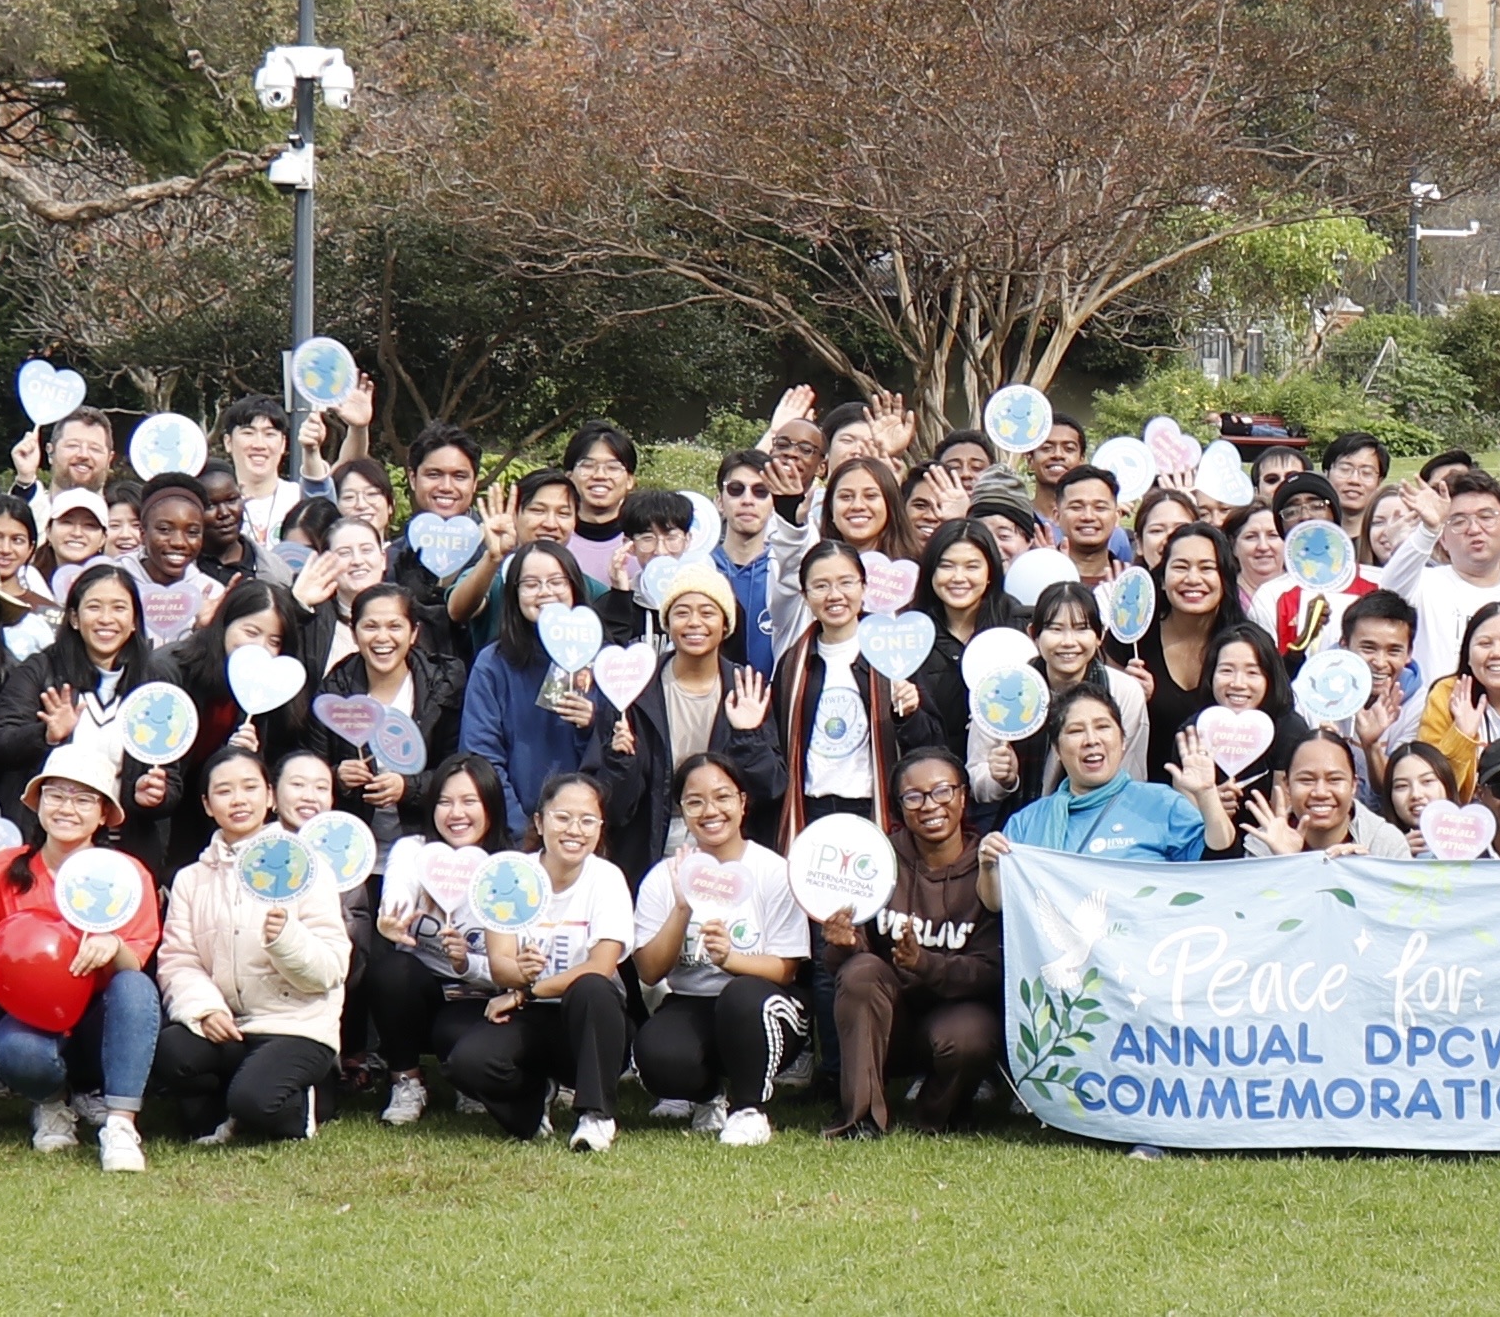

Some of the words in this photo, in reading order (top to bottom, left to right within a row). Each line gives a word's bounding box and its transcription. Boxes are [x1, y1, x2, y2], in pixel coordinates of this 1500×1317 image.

[869, 635, 924, 651] ONE!
[1442, 813, 1475, 825] PEACE
[1436, 826, 1457, 837] FOR
[1457, 828, 1476, 839] ALL
[806, 870, 875, 892] INTERNATIONAL
[1148, 924, 1349, 1021] Peace
[1384, 931, 1483, 1039] for
[1110, 1022, 1323, 1068] ANNUAL
